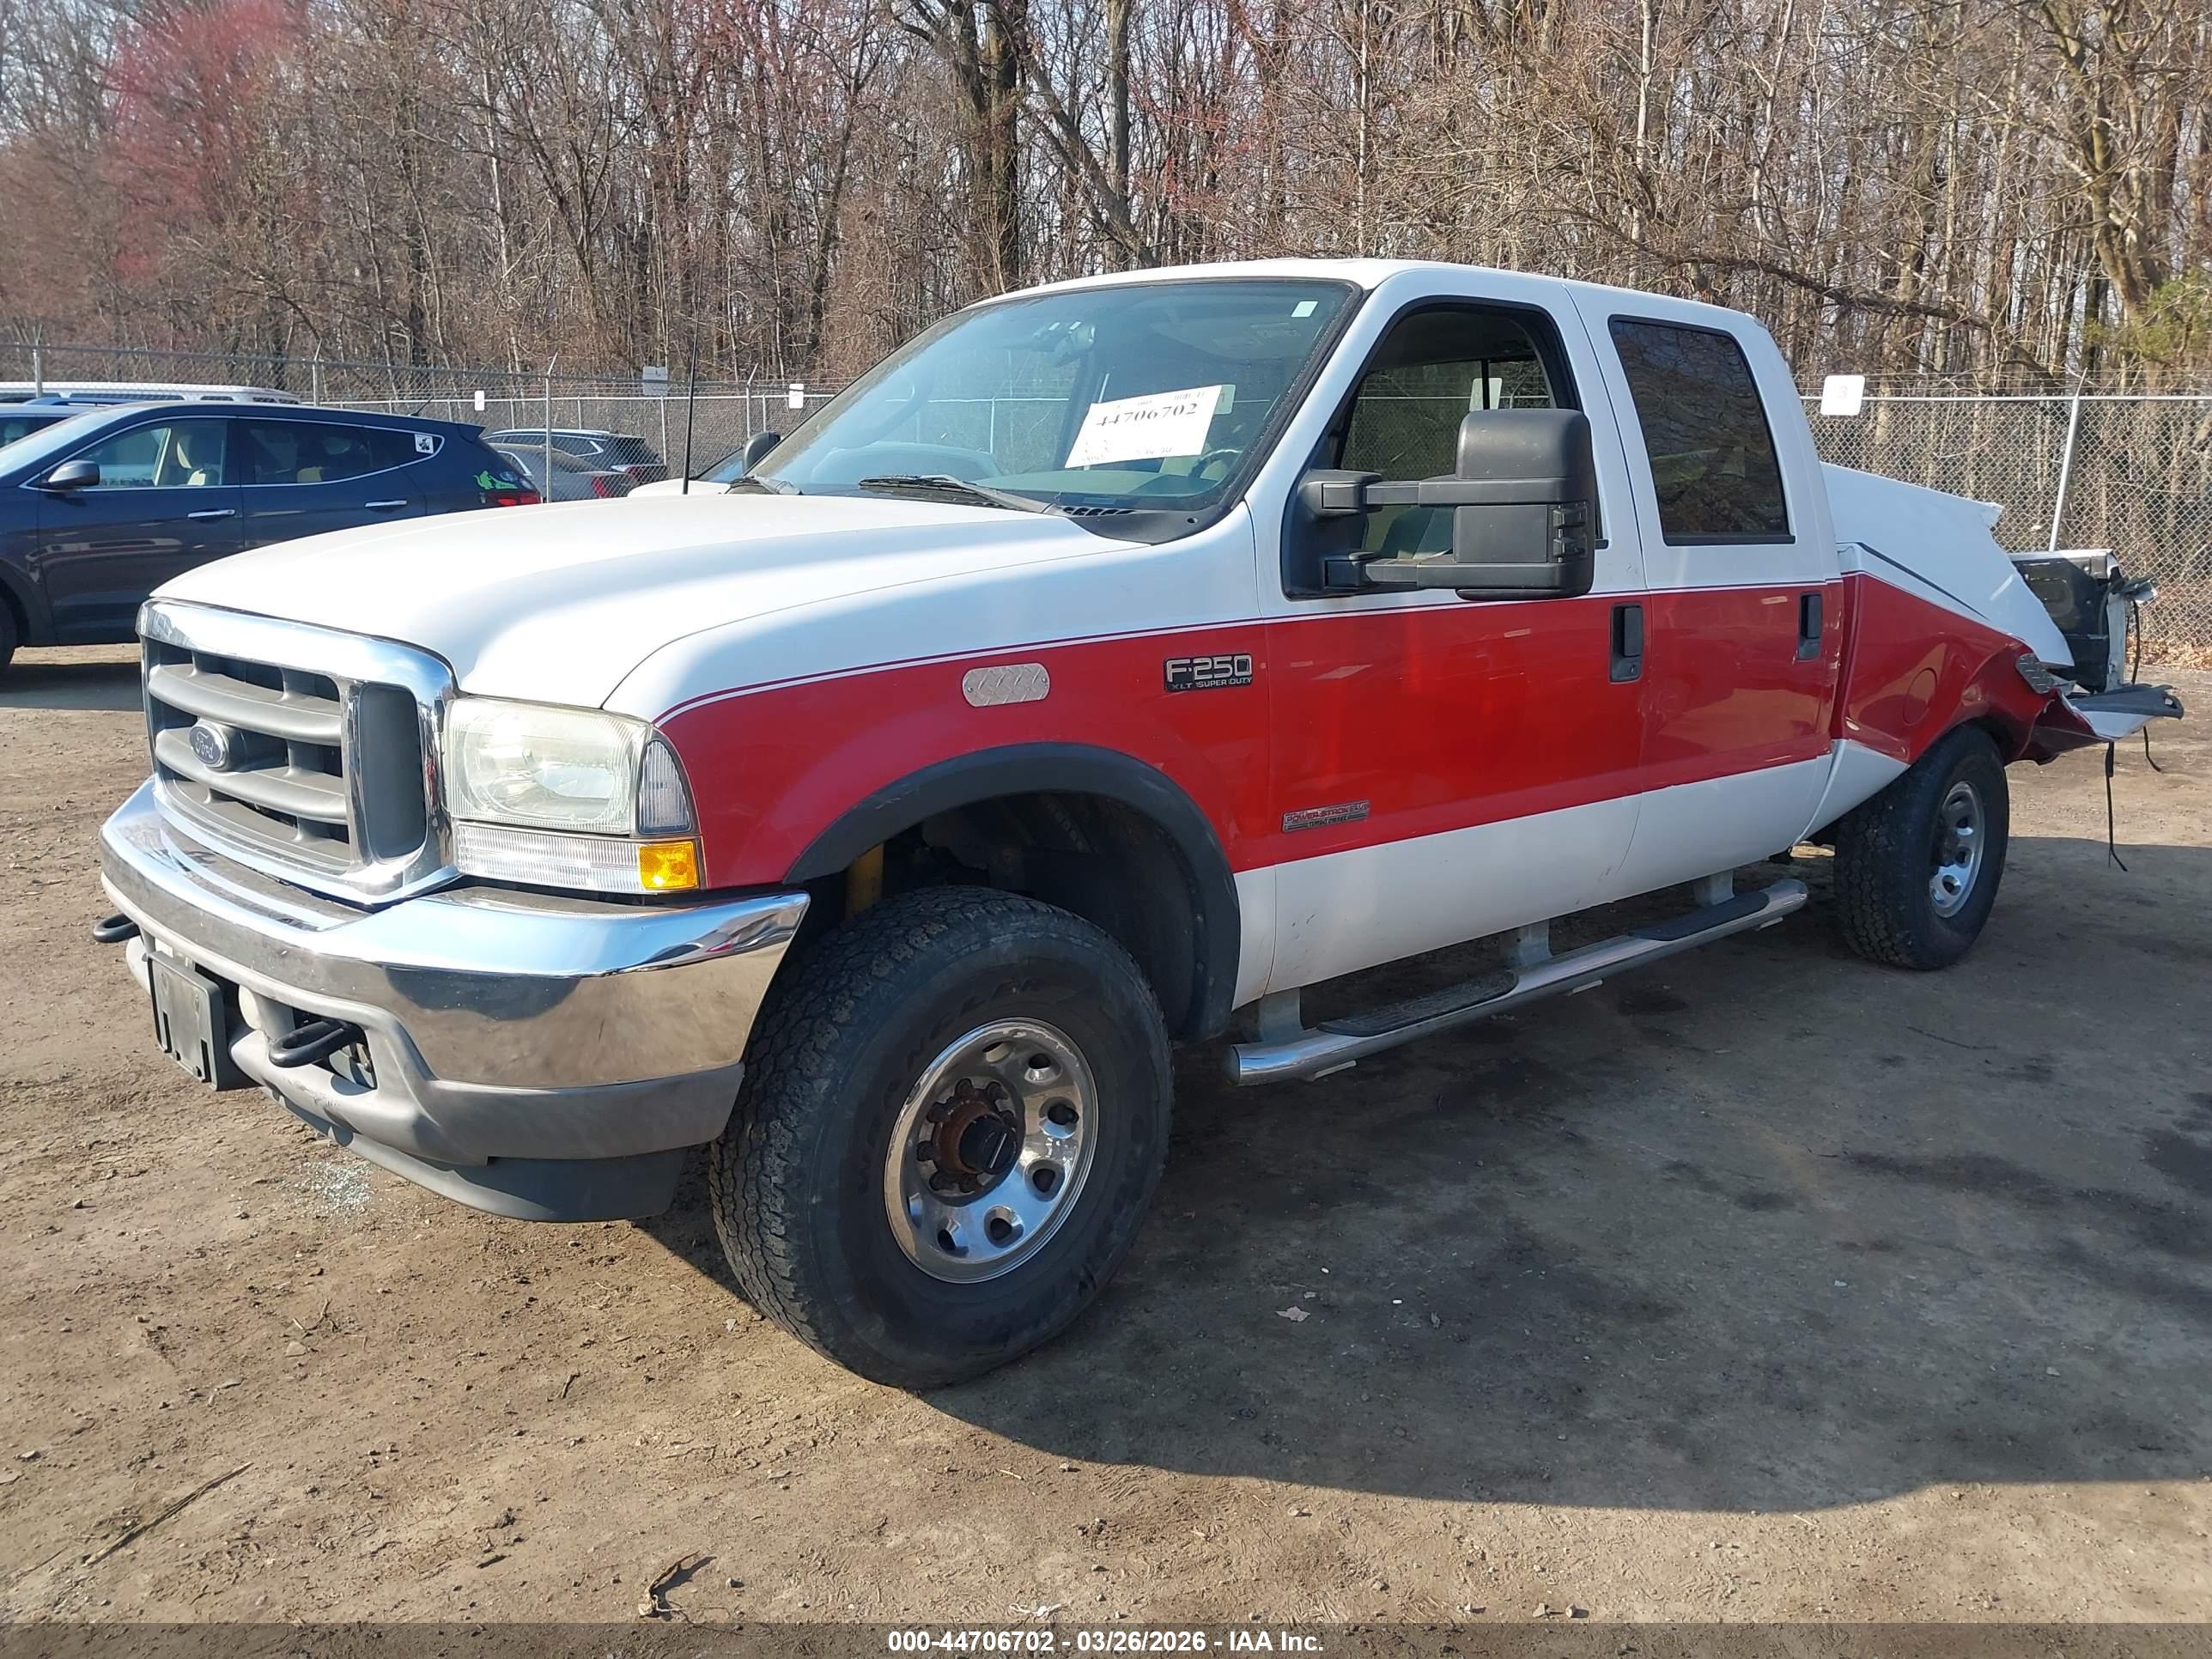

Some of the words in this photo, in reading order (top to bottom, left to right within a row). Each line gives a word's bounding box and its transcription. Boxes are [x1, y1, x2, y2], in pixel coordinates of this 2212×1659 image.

[1096, 403, 1198, 426] 44706702
[1171, 682, 1193, 690] XLT
[1196, 678, 1227, 688] SUPER
[1229, 677, 1253, 685] DUTY
[195, 731, 214, 760] Ford
